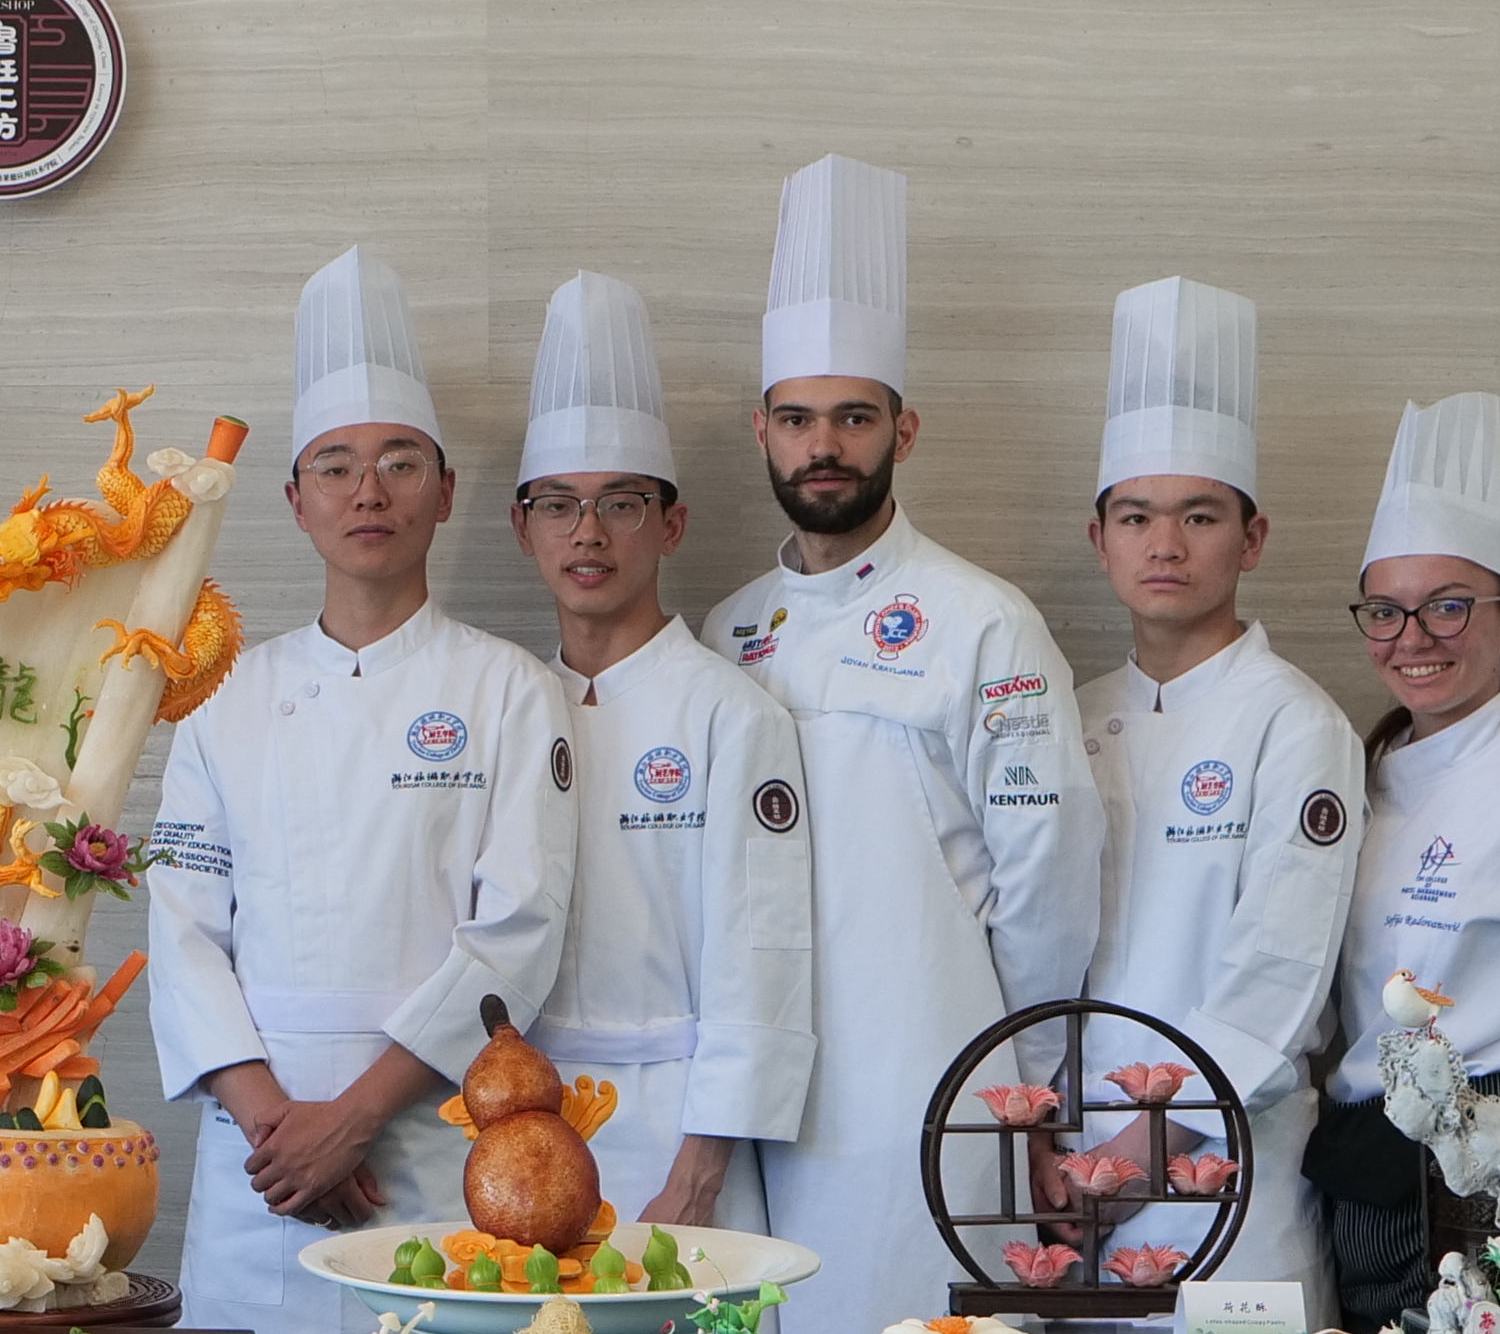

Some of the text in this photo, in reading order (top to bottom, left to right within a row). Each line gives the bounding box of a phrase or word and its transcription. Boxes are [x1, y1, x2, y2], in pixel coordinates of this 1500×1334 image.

[882, 629, 908, 640] JCC
[989, 793, 1060, 806] KENTAUR
[155, 822, 206, 833] RECOGNITION
[153, 829, 195, 840] OF QUALITY
[188, 842, 232, 856] EDUCATION
[178, 852, 233, 869] ASSOCIATION
[185, 862, 230, 878] SOCIETIES
